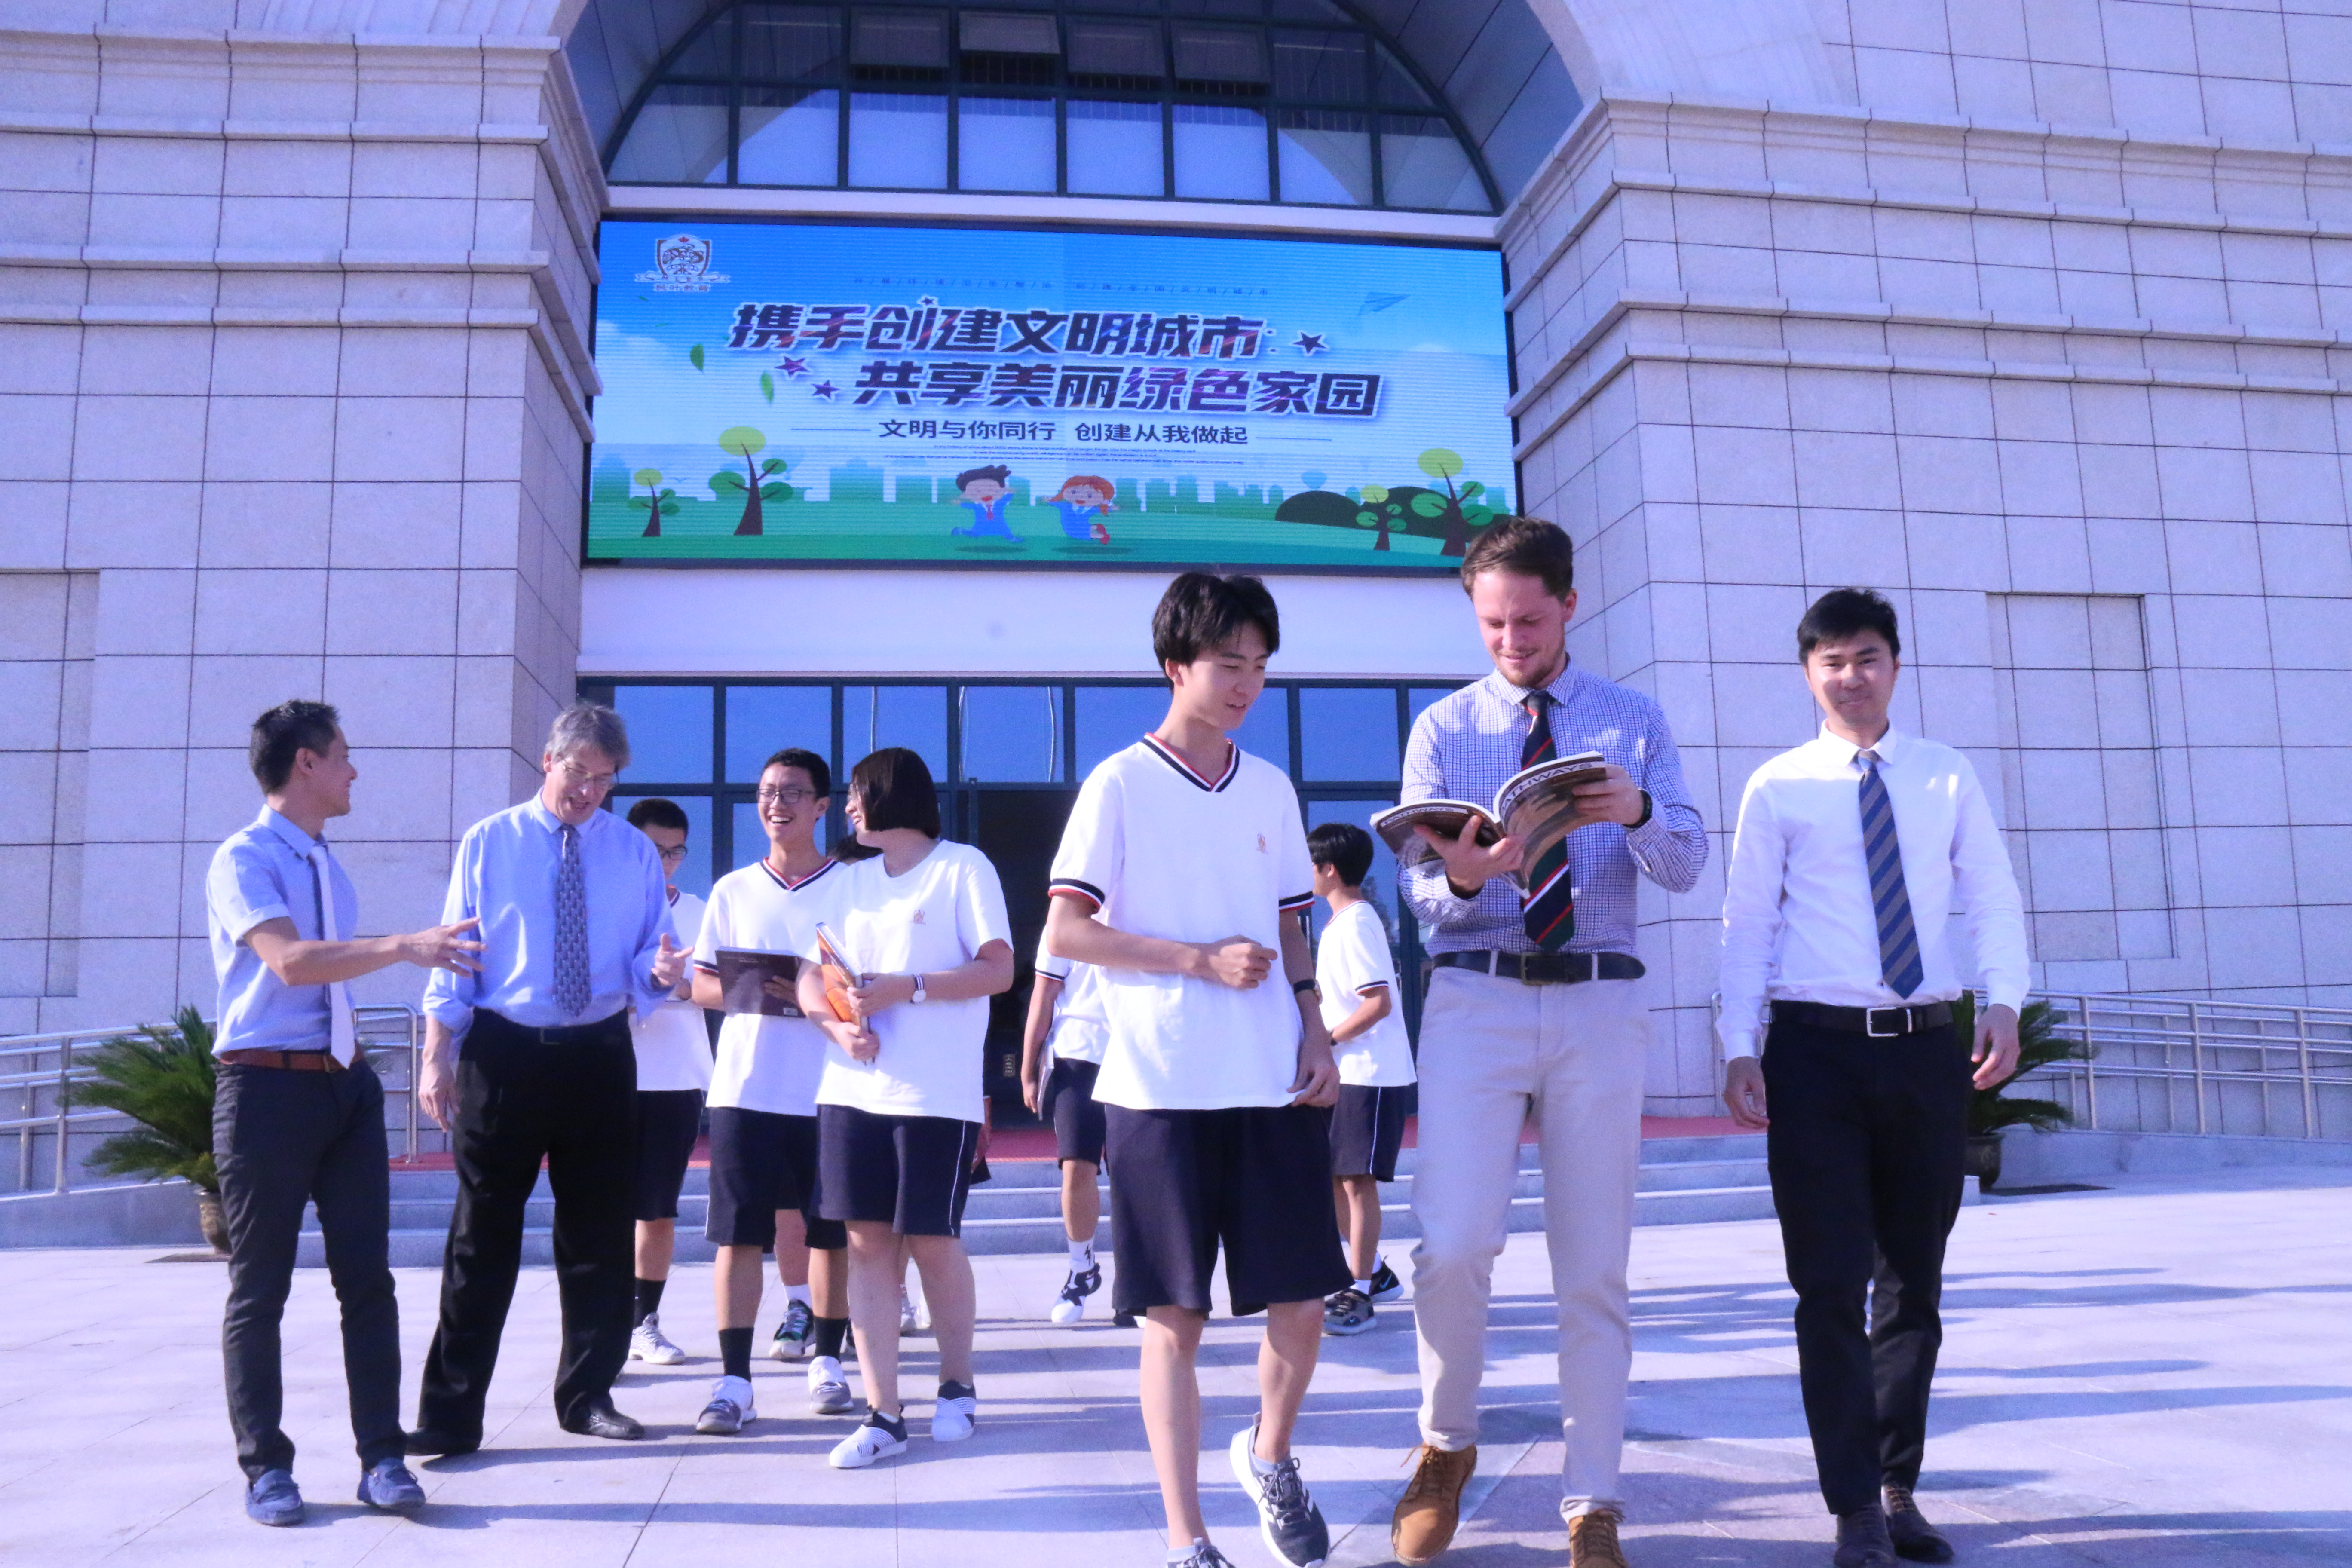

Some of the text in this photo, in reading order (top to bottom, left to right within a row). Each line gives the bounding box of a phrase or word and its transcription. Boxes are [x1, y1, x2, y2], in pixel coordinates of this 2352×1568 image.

[729, 304, 1263, 358] 携手创建文明城市
[854, 361, 1380, 416] 共享美丽绿色家园
[879, 419, 1248, 444] 文明与你同行 创建从我做起
